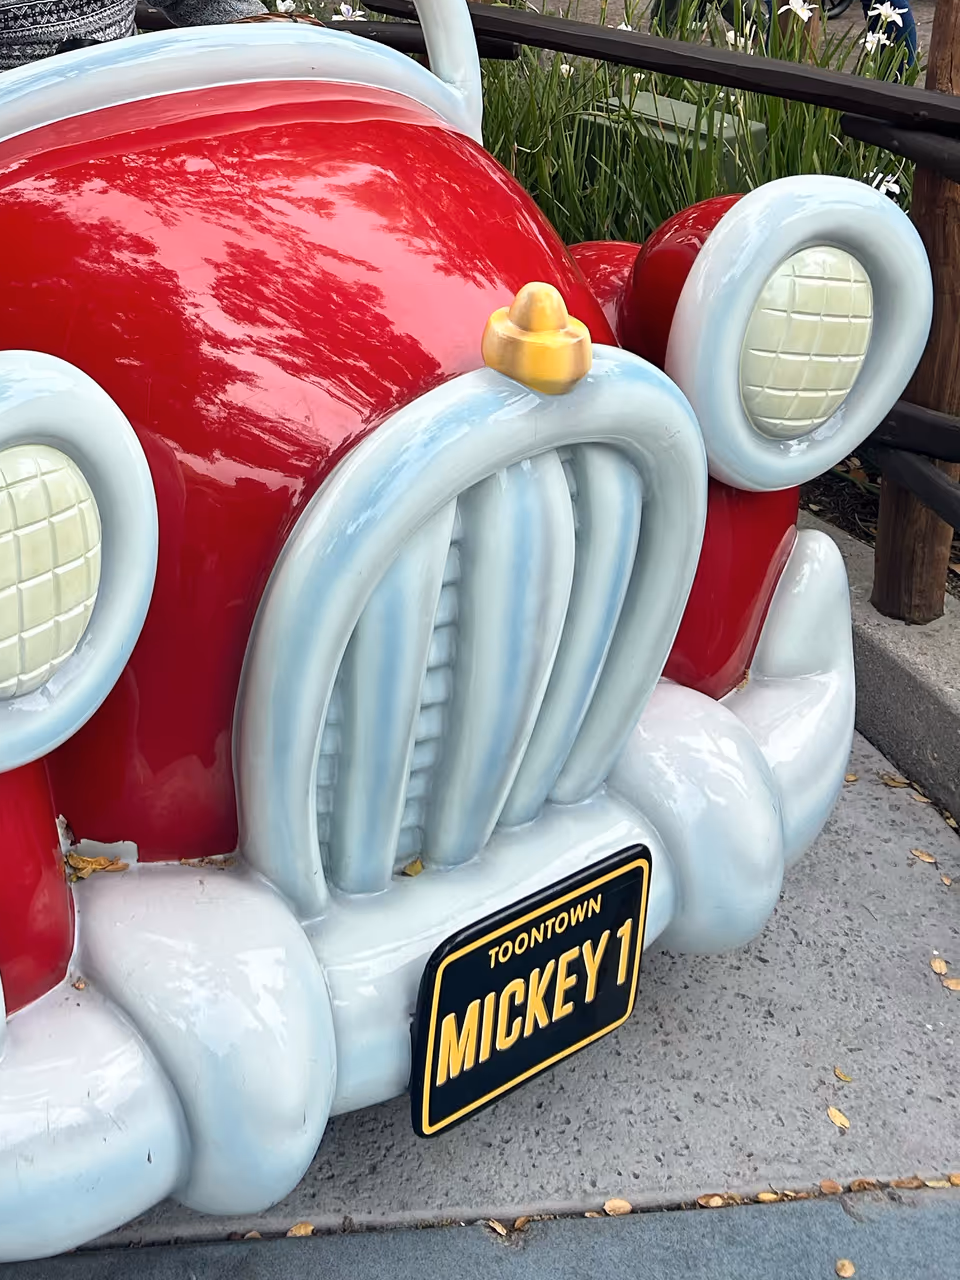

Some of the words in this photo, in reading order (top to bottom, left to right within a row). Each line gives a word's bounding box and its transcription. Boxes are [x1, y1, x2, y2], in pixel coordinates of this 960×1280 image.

[488, 893, 602, 969] TOONTOWN
[436, 929, 611, 1087] MICKEY
[616, 918, 633, 986] 1
